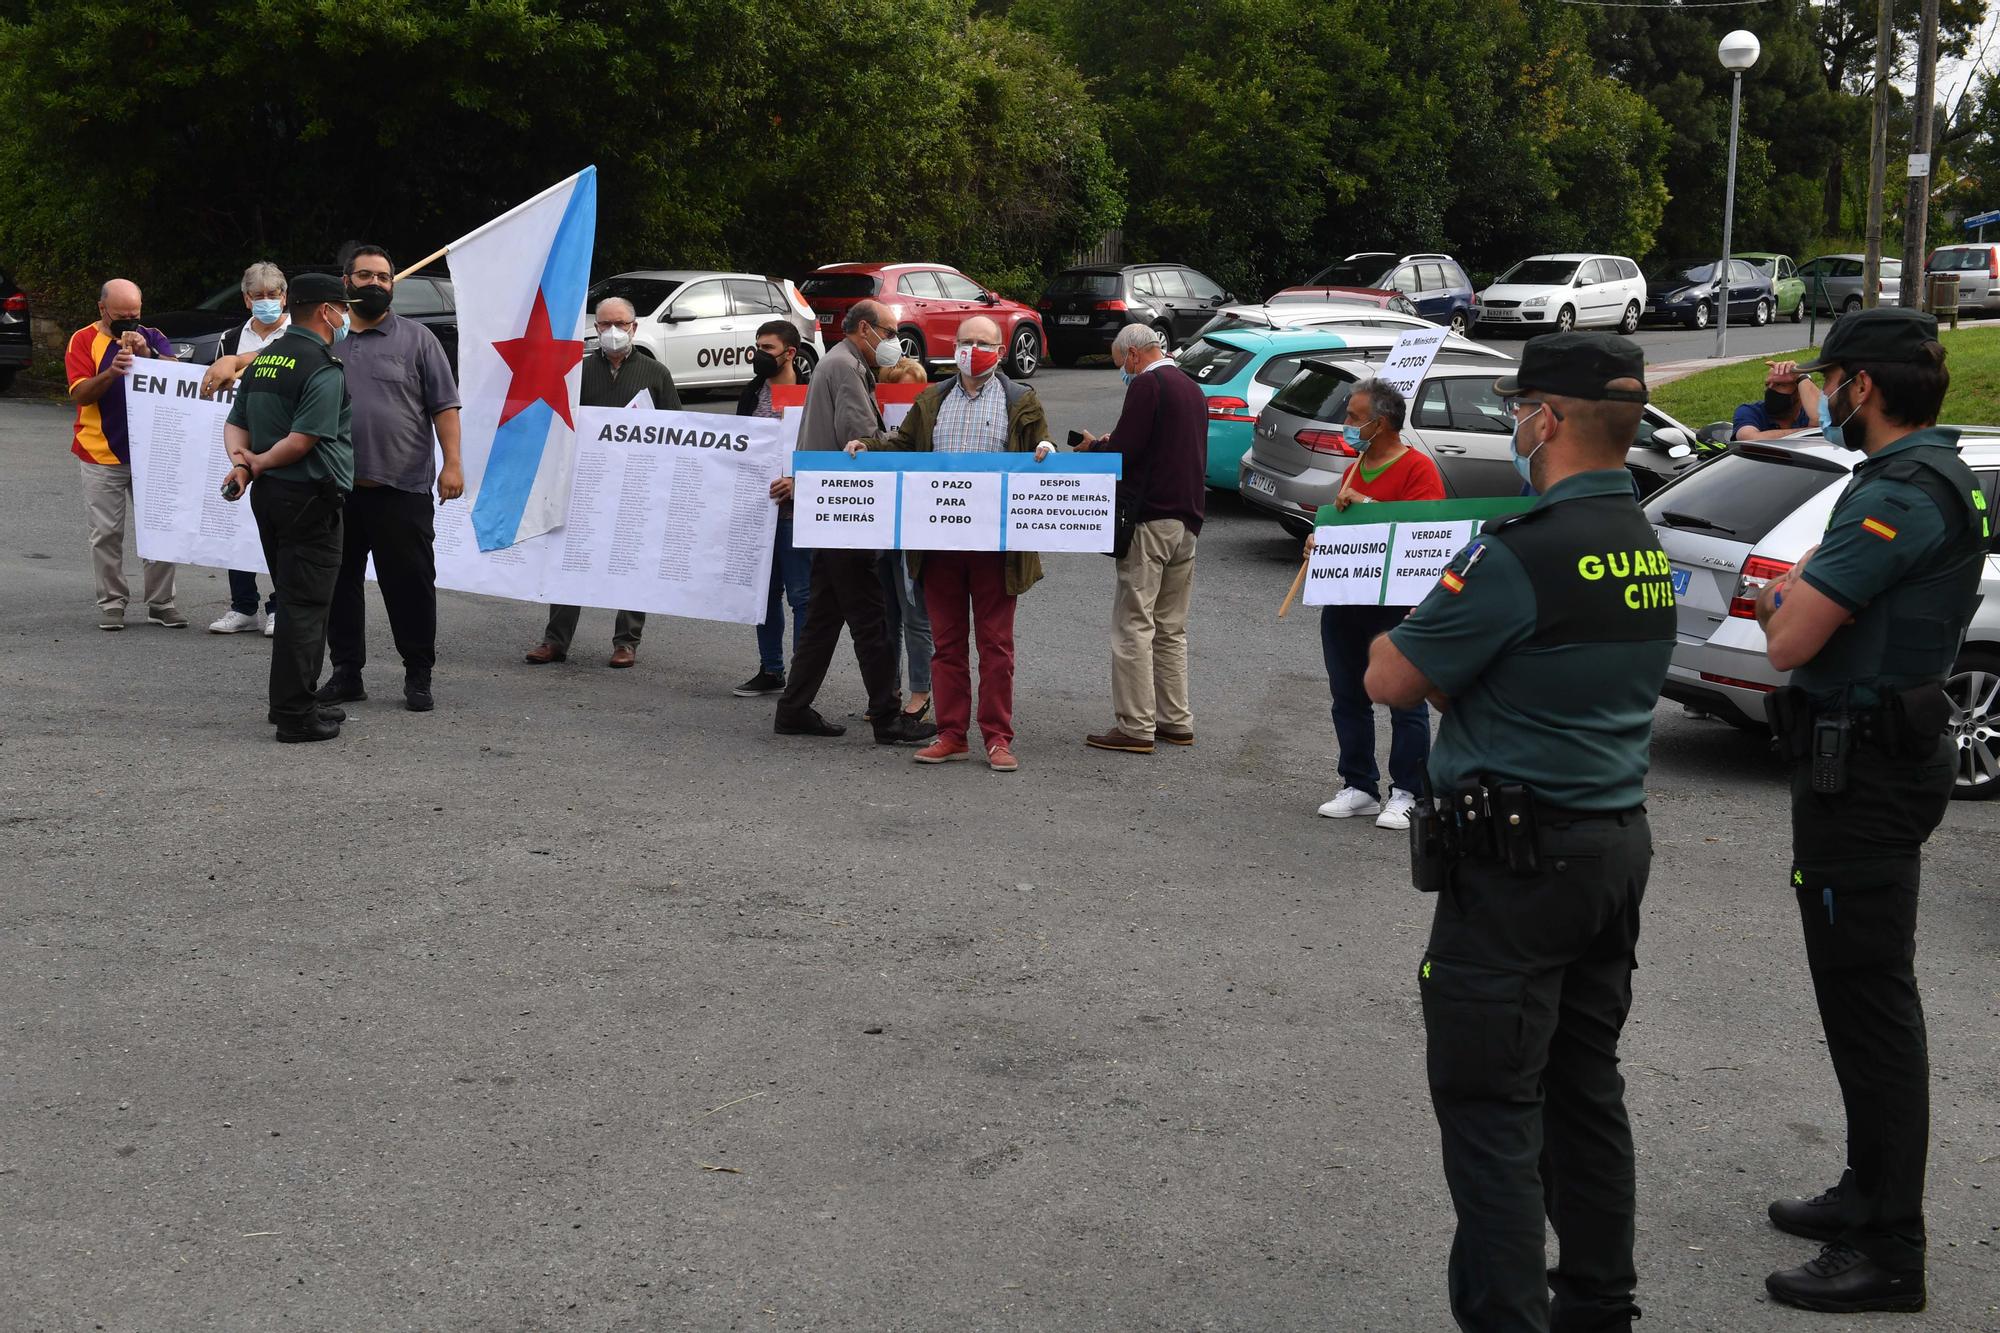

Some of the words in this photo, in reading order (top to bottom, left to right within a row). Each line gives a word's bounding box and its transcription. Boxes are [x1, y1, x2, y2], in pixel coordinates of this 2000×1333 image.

[1397, 355, 1427, 368] FOTOS
[255, 367, 278, 378] CIVIL
[132, 373, 167, 395] EN
[598, 423, 750, 452] ASASINADAS
[821, 479, 874, 488] PAREMOS
[931, 480, 939, 489] O
[942, 480, 972, 489] PAZO
[1040, 479, 1081, 487] DESPOIS
[816, 496, 824, 505] O
[828, 496, 875, 505] ESPOLIO
[936, 497, 966, 506] PARA
[1012, 493, 1025, 501] DO
[1028, 493, 1054, 502] PAZO
[1071, 493, 1111, 503] MEIRÁS,
[815, 513, 830, 522] DE
[833, 511, 875, 522] MEIRÁS
[1046, 508, 1108, 516] DEVOLUCIÓN
[929, 514, 937, 523] O
[940, 515, 972, 524] POBO
[1031, 522, 1057, 530] CASA
[1059, 523, 1102, 531] CORNIDE
[1411, 529, 1453, 540] VERDADE
[1313, 542, 1387, 556] FRANQUISMO
[1404, 549, 1442, 559] XUSTIZA
[1444, 549, 1451, 558] E
[1577, 550, 1672, 581] GUARD
[1311, 567, 1349, 579] NUNCA
[1352, 564, 1382, 579] MÁIS
[1624, 581, 1674, 610] CIVIL
